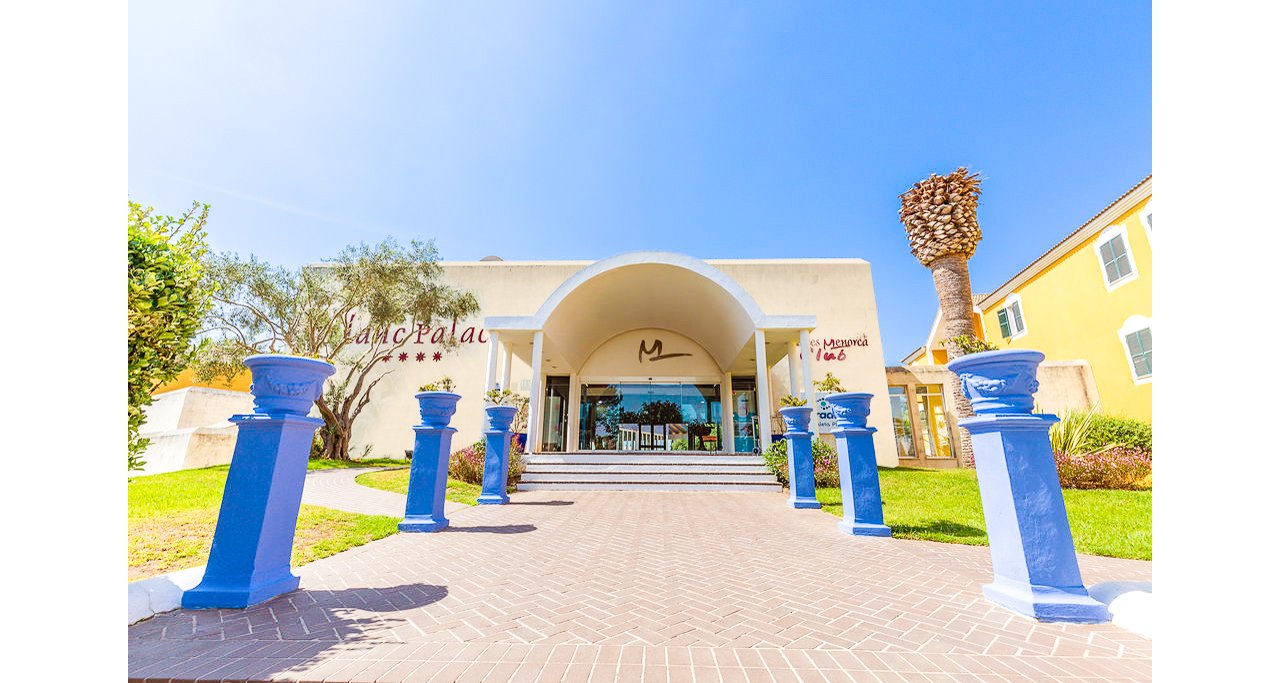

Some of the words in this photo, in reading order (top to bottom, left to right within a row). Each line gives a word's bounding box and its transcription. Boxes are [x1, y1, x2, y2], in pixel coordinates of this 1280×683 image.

[344, 314, 406, 345] lanc
[413, 316, 489, 345] Palac
[823, 338, 869, 350] Menorca
